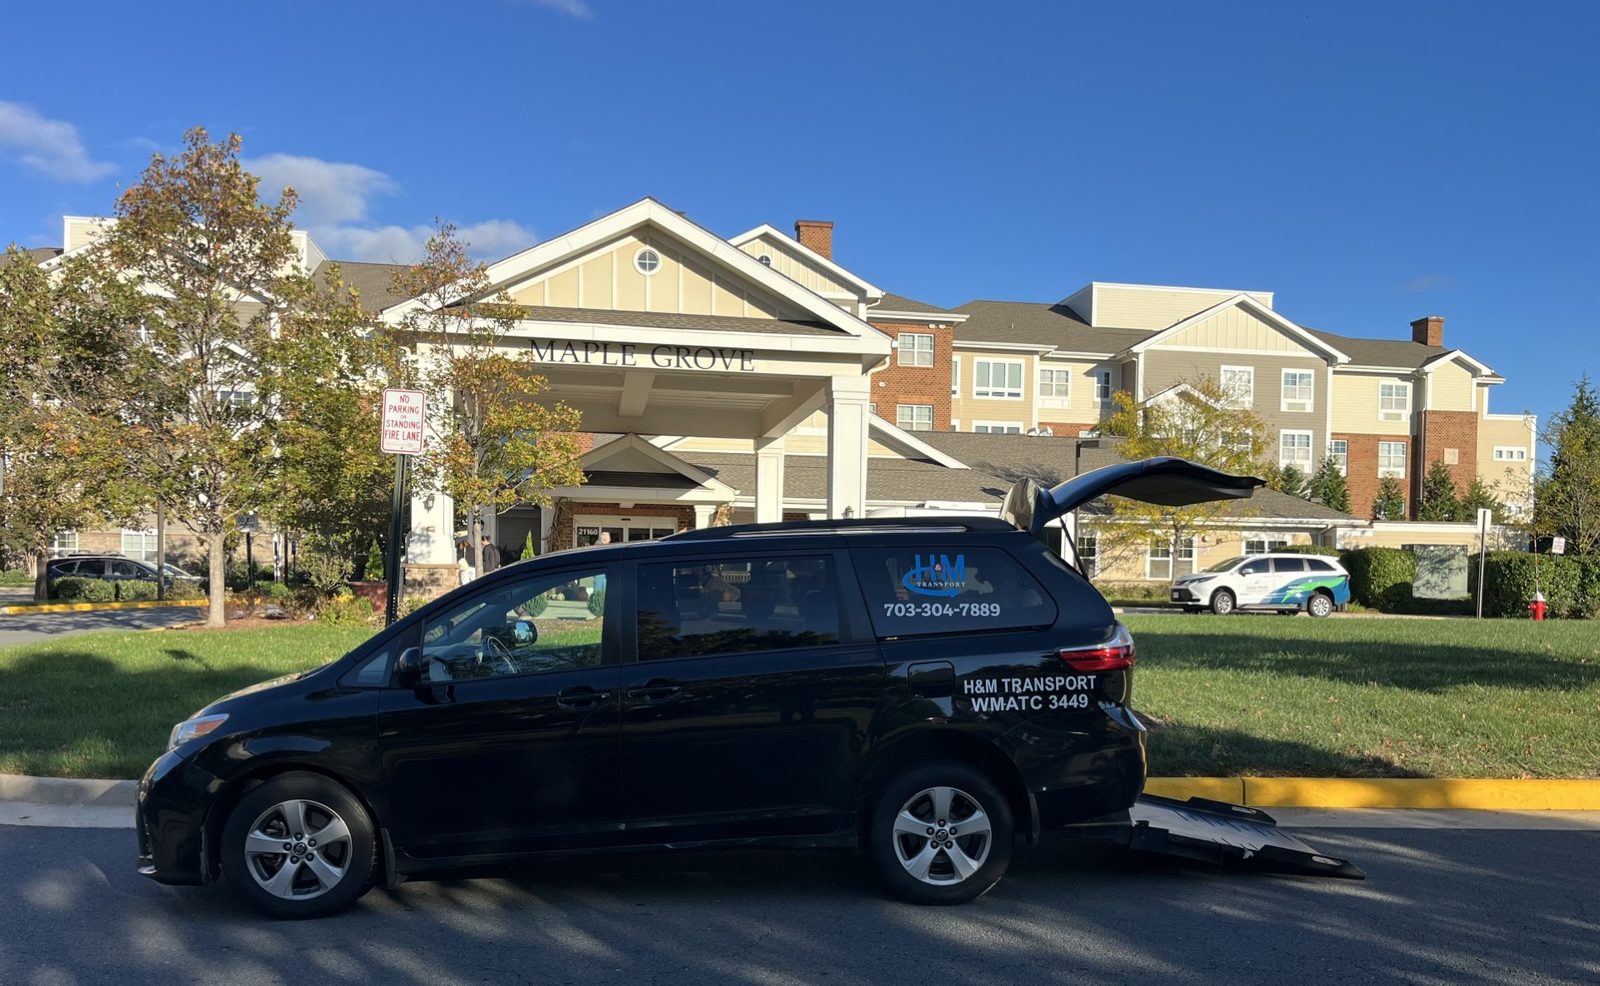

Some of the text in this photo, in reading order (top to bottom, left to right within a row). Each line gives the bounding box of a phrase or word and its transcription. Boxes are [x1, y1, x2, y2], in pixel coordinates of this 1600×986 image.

[528, 339, 754, 371] MAPLE GROVE
[399, 394, 410, 403] NO
[388, 404, 419, 414] PARKING
[386, 419, 420, 429] STANDING
[384, 430, 420, 441] FIRE LANE
[578, 528, 598, 536] 21160
[914, 553, 966, 582] H&M
[884, 603, 1001, 617] 703-304-7889
[963, 674, 1097, 695] H&M TRANSPORT
[971, 693, 1089, 713] WMATC 3449
